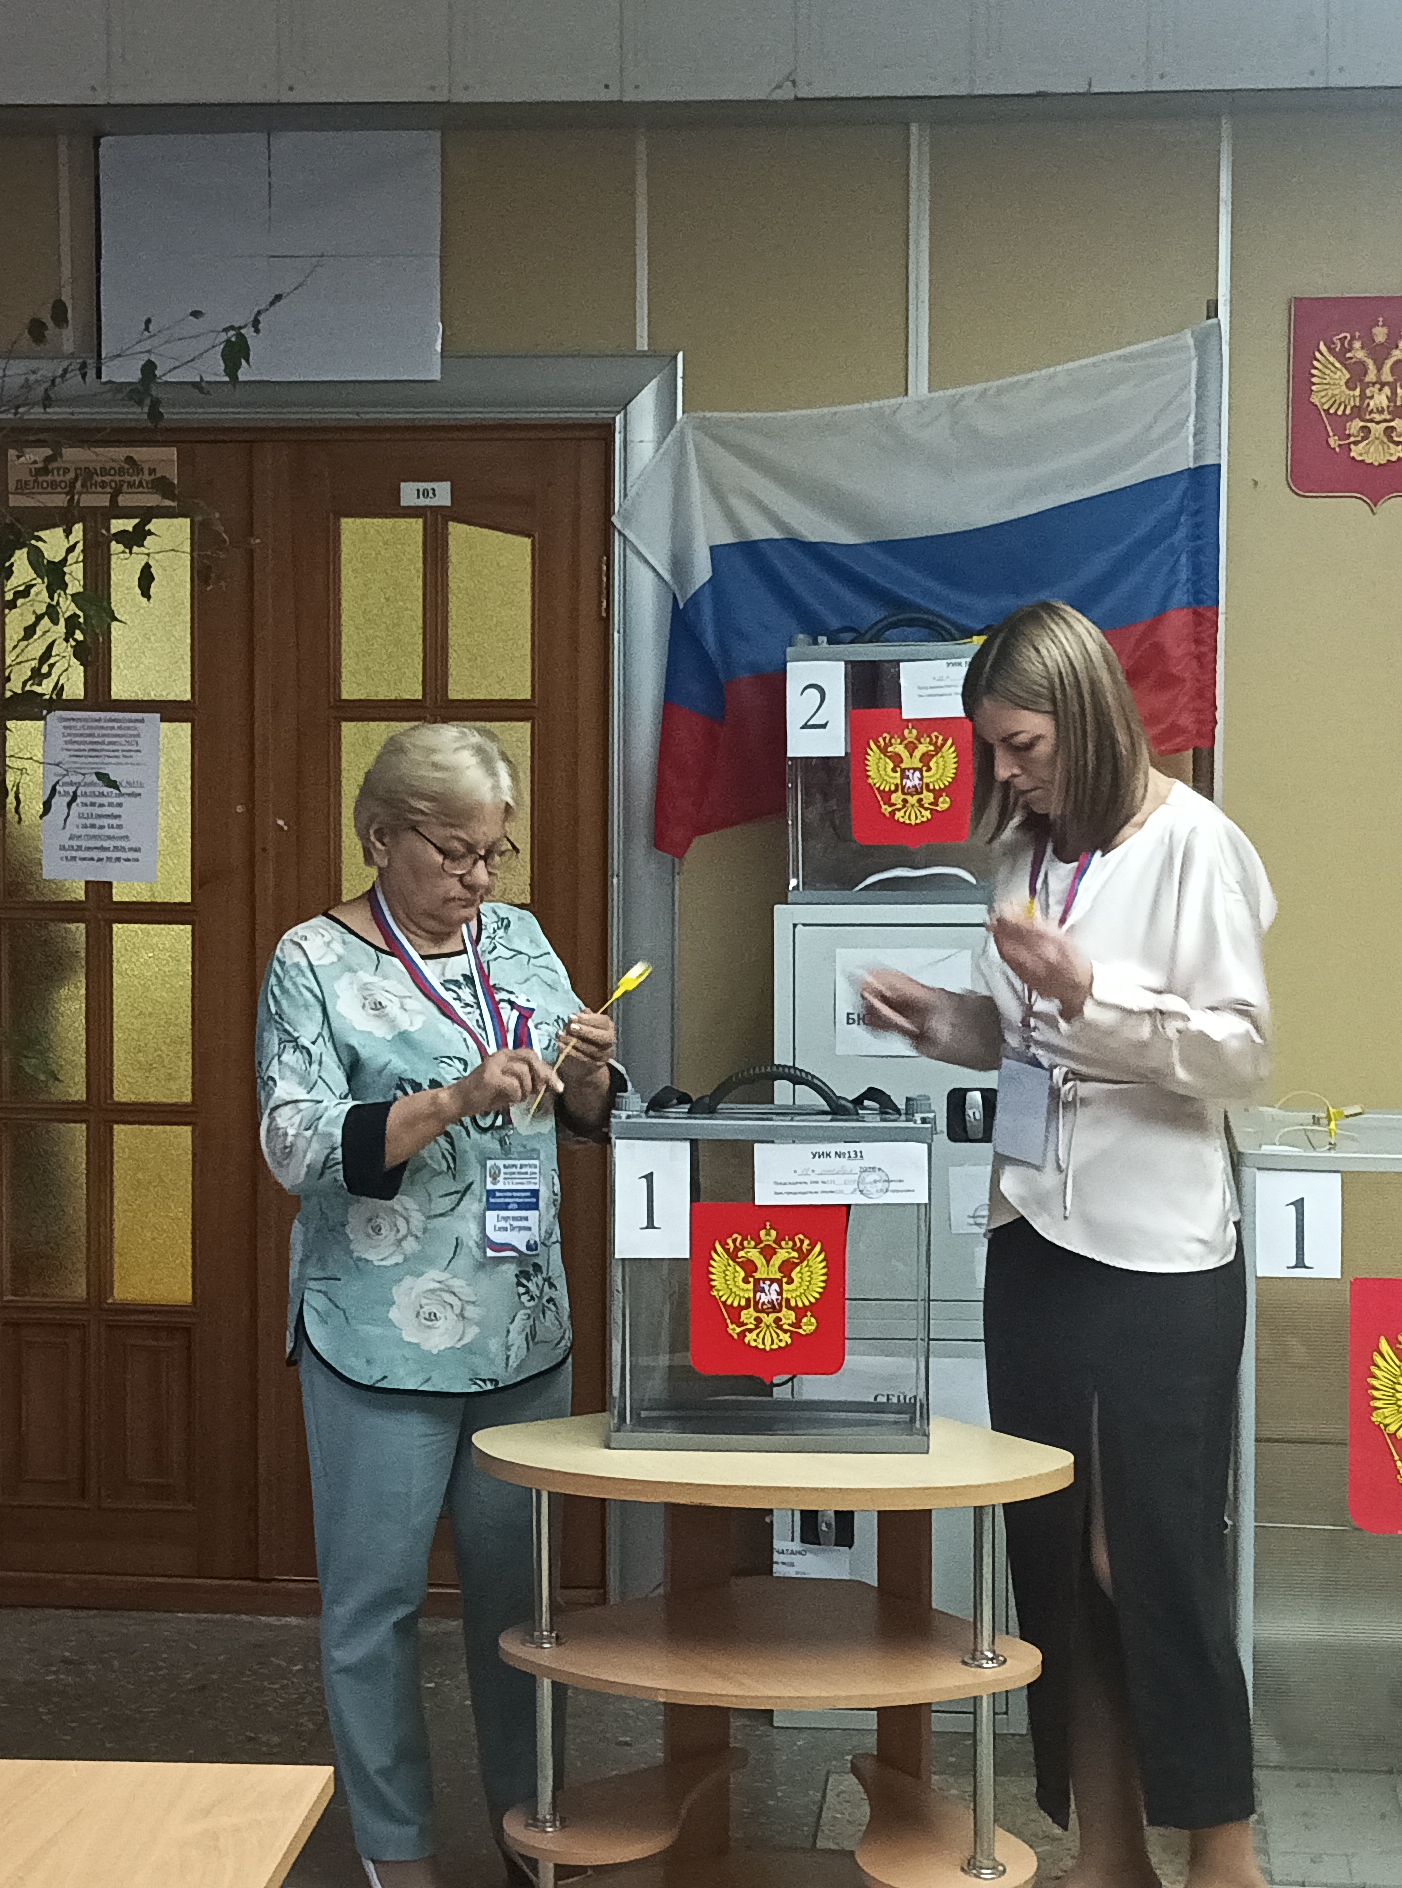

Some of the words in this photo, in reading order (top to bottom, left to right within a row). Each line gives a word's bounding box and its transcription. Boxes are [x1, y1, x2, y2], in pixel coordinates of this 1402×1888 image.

[416, 488, 436, 499] 103
[799, 683, 830, 730] 2
[811, 1151, 831, 1159] УИК
[834, 1150, 864, 1160] №131
[638, 1171, 661, 1230] 1
[1285, 1196, 1314, 1270] 1
